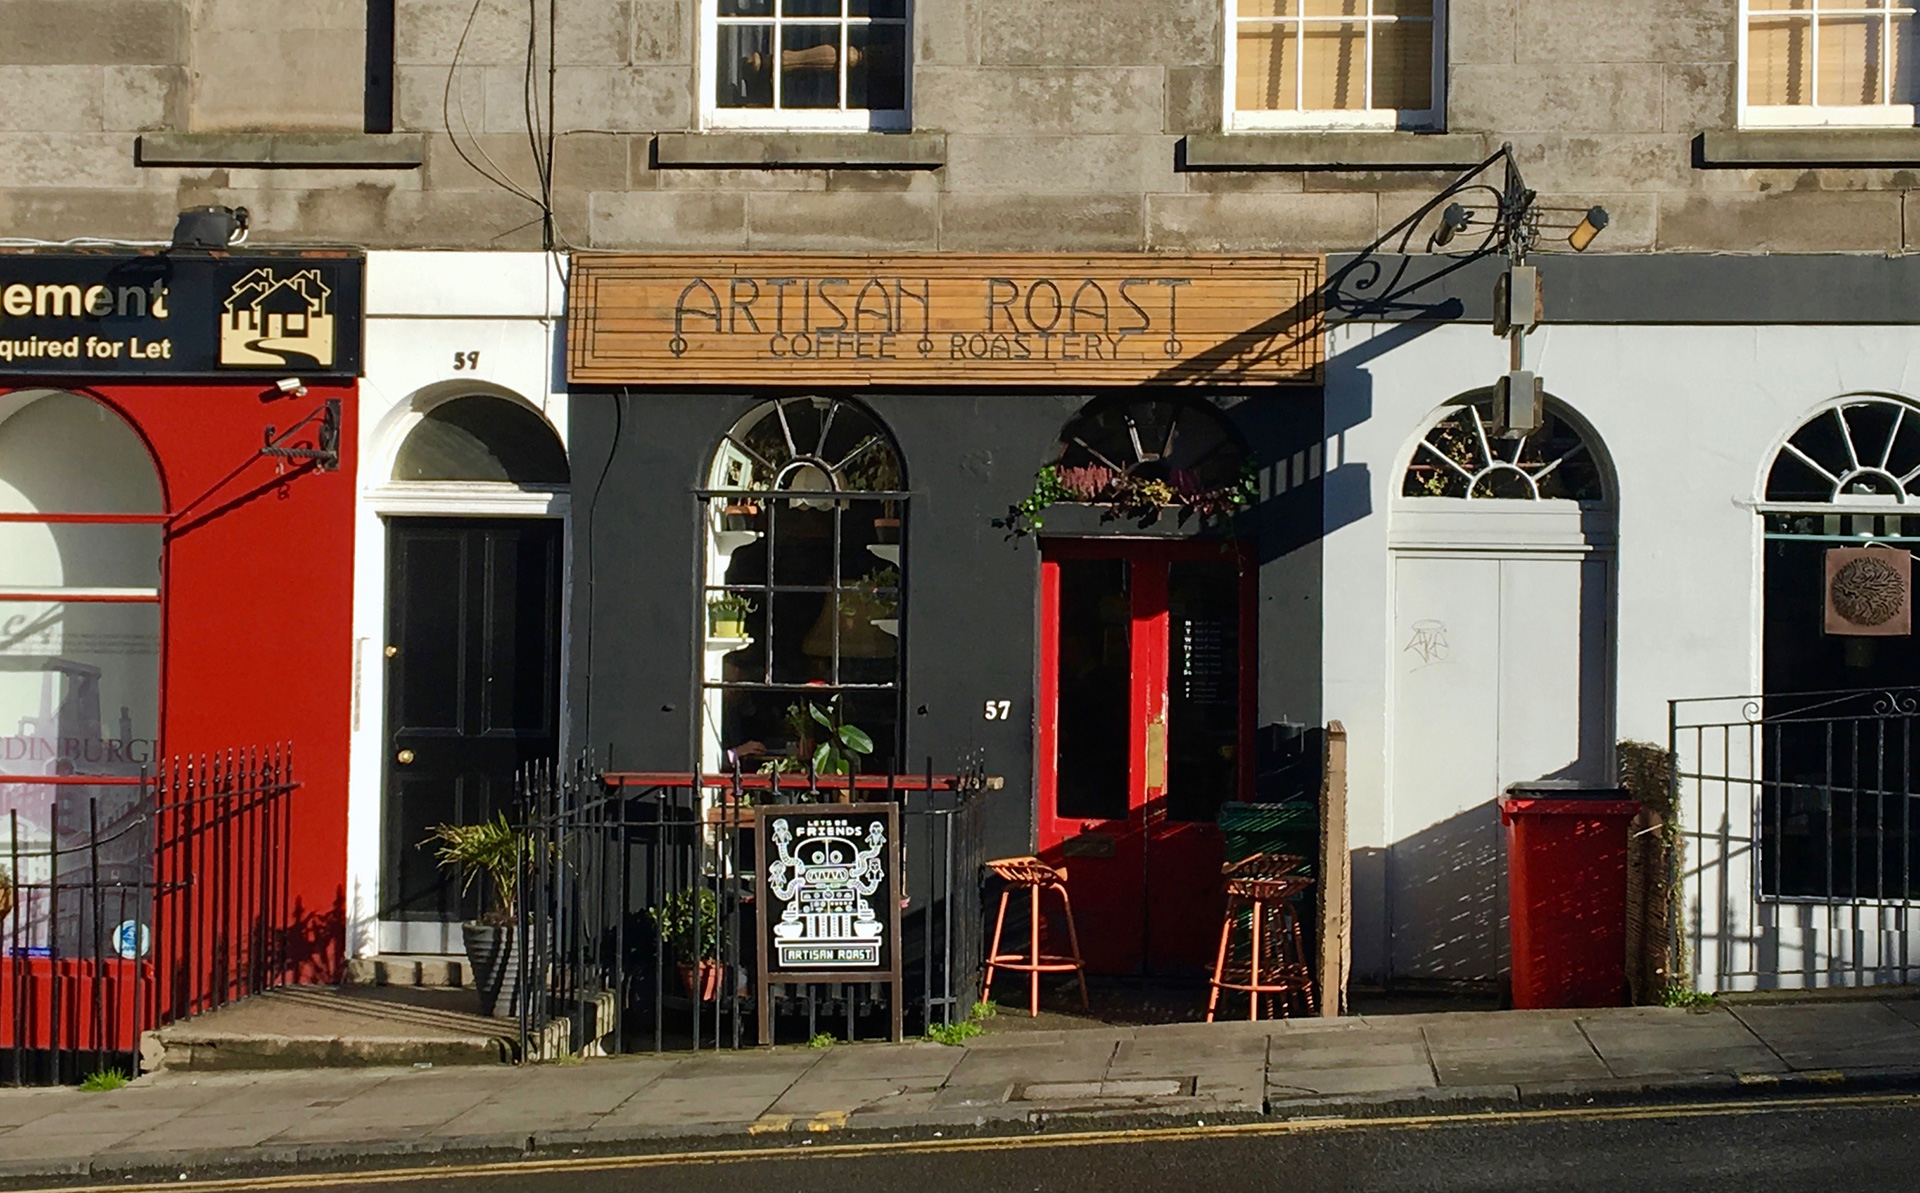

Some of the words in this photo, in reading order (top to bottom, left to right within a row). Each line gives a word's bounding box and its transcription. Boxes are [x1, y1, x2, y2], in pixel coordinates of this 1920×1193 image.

[0, 278, 169, 318] ement
[669, 277, 933, 358] ARTISAN
[986, 278, 1192, 359] ROAST
[86, 336, 124, 358] for
[130, 337, 172, 359] Let
[769, 332, 898, 359] COFFEE
[950, 332, 1127, 360] ROASTERY
[453, 350, 481, 370] 59
[985, 700, 1011, 720] 57
[0, 736, 158, 763] DINBURG
[796, 826, 862, 837] FRIENDS
[788, 949, 834, 960] ARTISAN
[838, 949, 872, 960] ROAST
